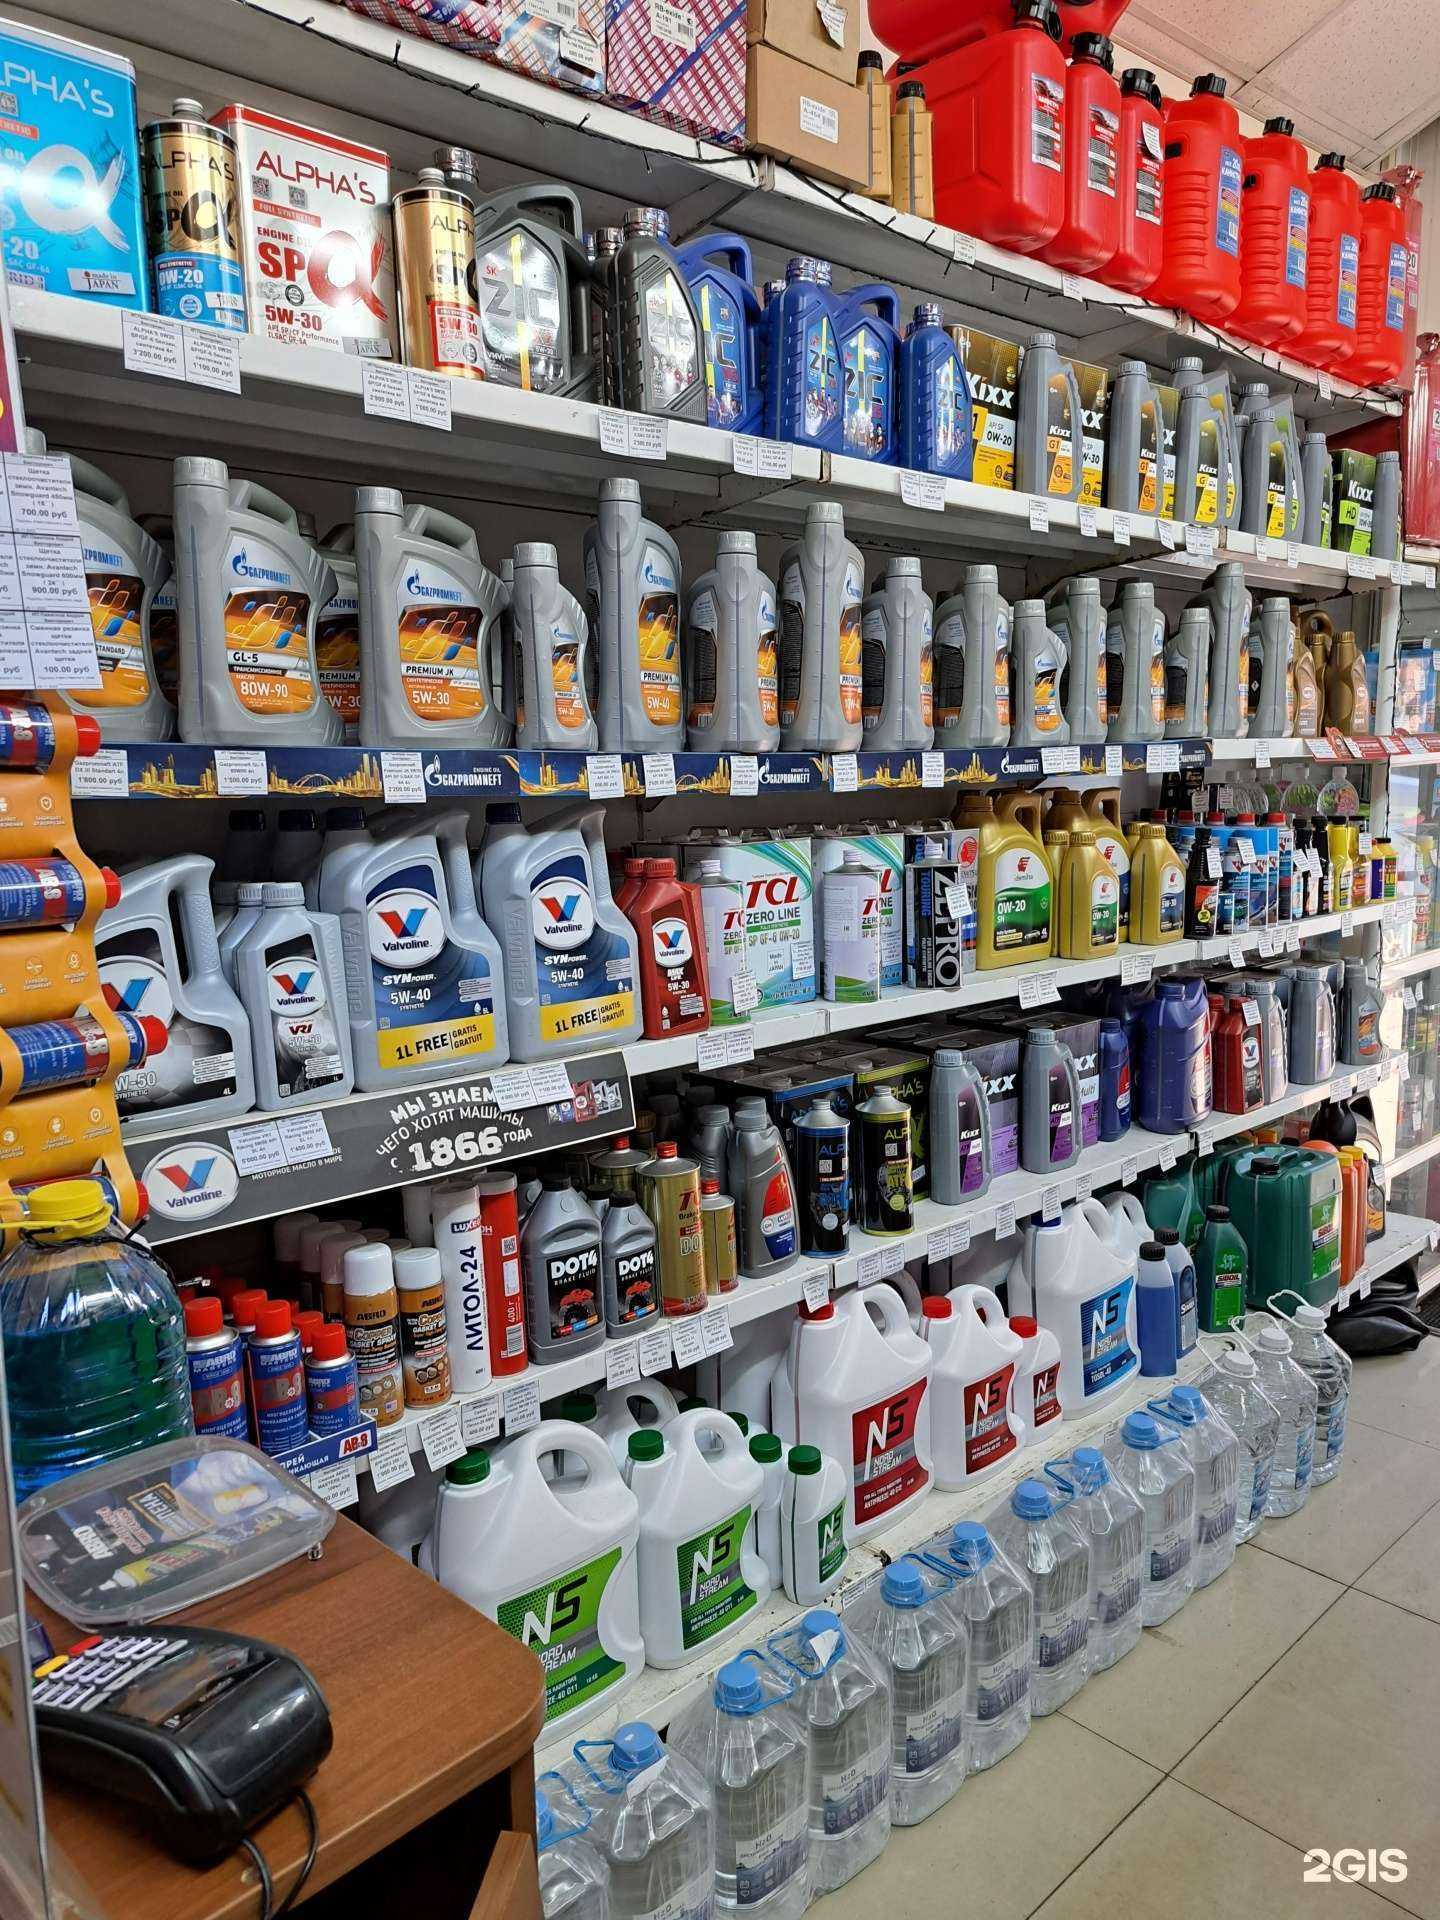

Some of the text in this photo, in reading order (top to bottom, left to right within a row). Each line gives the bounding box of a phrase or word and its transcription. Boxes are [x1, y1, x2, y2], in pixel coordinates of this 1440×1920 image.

[0, 62, 114, 118] PHA'S
[256, 151, 376, 206] ALPHA'S
[257, 226, 295, 244] ENGINE
[259, 242, 305, 282] SP
[159, 269, 204, 285] 0W-20
[265, 305, 322, 331] 5W-30
[164, 354, 177, 364] руб
[967, 371, 1015, 410] Kixx
[986, 429, 1013, 447] 0W-20
[1050, 425, 1071, 438] Kixx
[1348, 479, 1374, 503] Kixx
[21, 508, 68, 519] 700.00 руб
[248, 566, 292, 586] GAZPROMNEFT
[32, 586, 78, 596] 900.00 руб
[421, 586, 464, 603] GAZPROMNEFT
[233, 651, 259, 664] GL-5
[74, 666, 90, 674] руб
[319, 671, 357, 681] REMIUM
[406, 665, 454, 677] PREMIUM JK
[240, 680, 289, 699] 80W-90
[412, 692, 450, 706] 5W-30
[647, 696, 670, 710] 5W-40
[109, 777, 123, 785] руб
[443, 773, 502, 787] GAZPROMNEFT
[769, 771, 810, 784] GAZPROMNEFT
[746, 876, 800, 909] TCL
[747, 906, 800, 925] ZERO LINE
[997, 899, 1026, 915] 0W-20
[1092, 909, 1110, 921] 0W-20
[544, 922, 583, 935] Valvoline
[935, 870, 960, 986] ZPRO
[382, 939, 431, 952] Valvoline
[659, 949, 685, 957] Valvoline
[551, 967, 584, 983] 5W-40
[667, 981, 690, 992] 5W-30
[276, 995, 316, 1007] Valvoline
[390, 988, 431, 1005] 5W-40
[600, 1000, 621, 1014] GRATIS
[555, 1008, 597, 1034] 1L FREE
[601, 1009, 625, 1024] GRATUIT
[288, 1024, 313, 1035] VR1
[452, 1024, 477, 1039] GRATIS
[288, 1034, 321, 1049] 5W-50
[395, 1033, 449, 1061] 1L FREE
[454, 1033, 483, 1049] GRATUIT
[115, 1071, 157, 1092] W-50
[983, 1074, 1016, 1096] ixx
[390, 1093, 426, 1125] МЫ
[1051, 1103, 1070, 1112] Kixx
[376, 1106, 524, 1156] ЧЕГО ХОТЯТ МАШИНЫ
[961, 1128, 980, 1140] Kixx
[408, 1126, 503, 1171] 1866
[504, 1127, 533, 1143] ГОДА
[251, 1166, 291, 1181] МОТОРНОЕ
[292, 1162, 317, 1174] МАСЛО
[323, 1154, 343, 1165] МИРЕ
[166, 1189, 223, 1209] Valvoline
[550, 1248, 598, 1280] DOT4
[618, 1249, 655, 1277] DOT4
[554, 1267, 597, 1287] BRAKE FLUID
[460, 1245, 484, 1352] ЛИТОЛ-24
[356, 1309, 387, 1321] ABRO
[872, 1454, 902, 1477] STREAM
[873, 1450, 894, 1468] NORD
[698, 1575, 729, 1601] STREAM
[699, 1573, 721, 1593] NORD
[540, 1643, 563, 1664] ORD
[543, 1646, 577, 1673] REAM
[566, 1683, 578, 1696] G11
